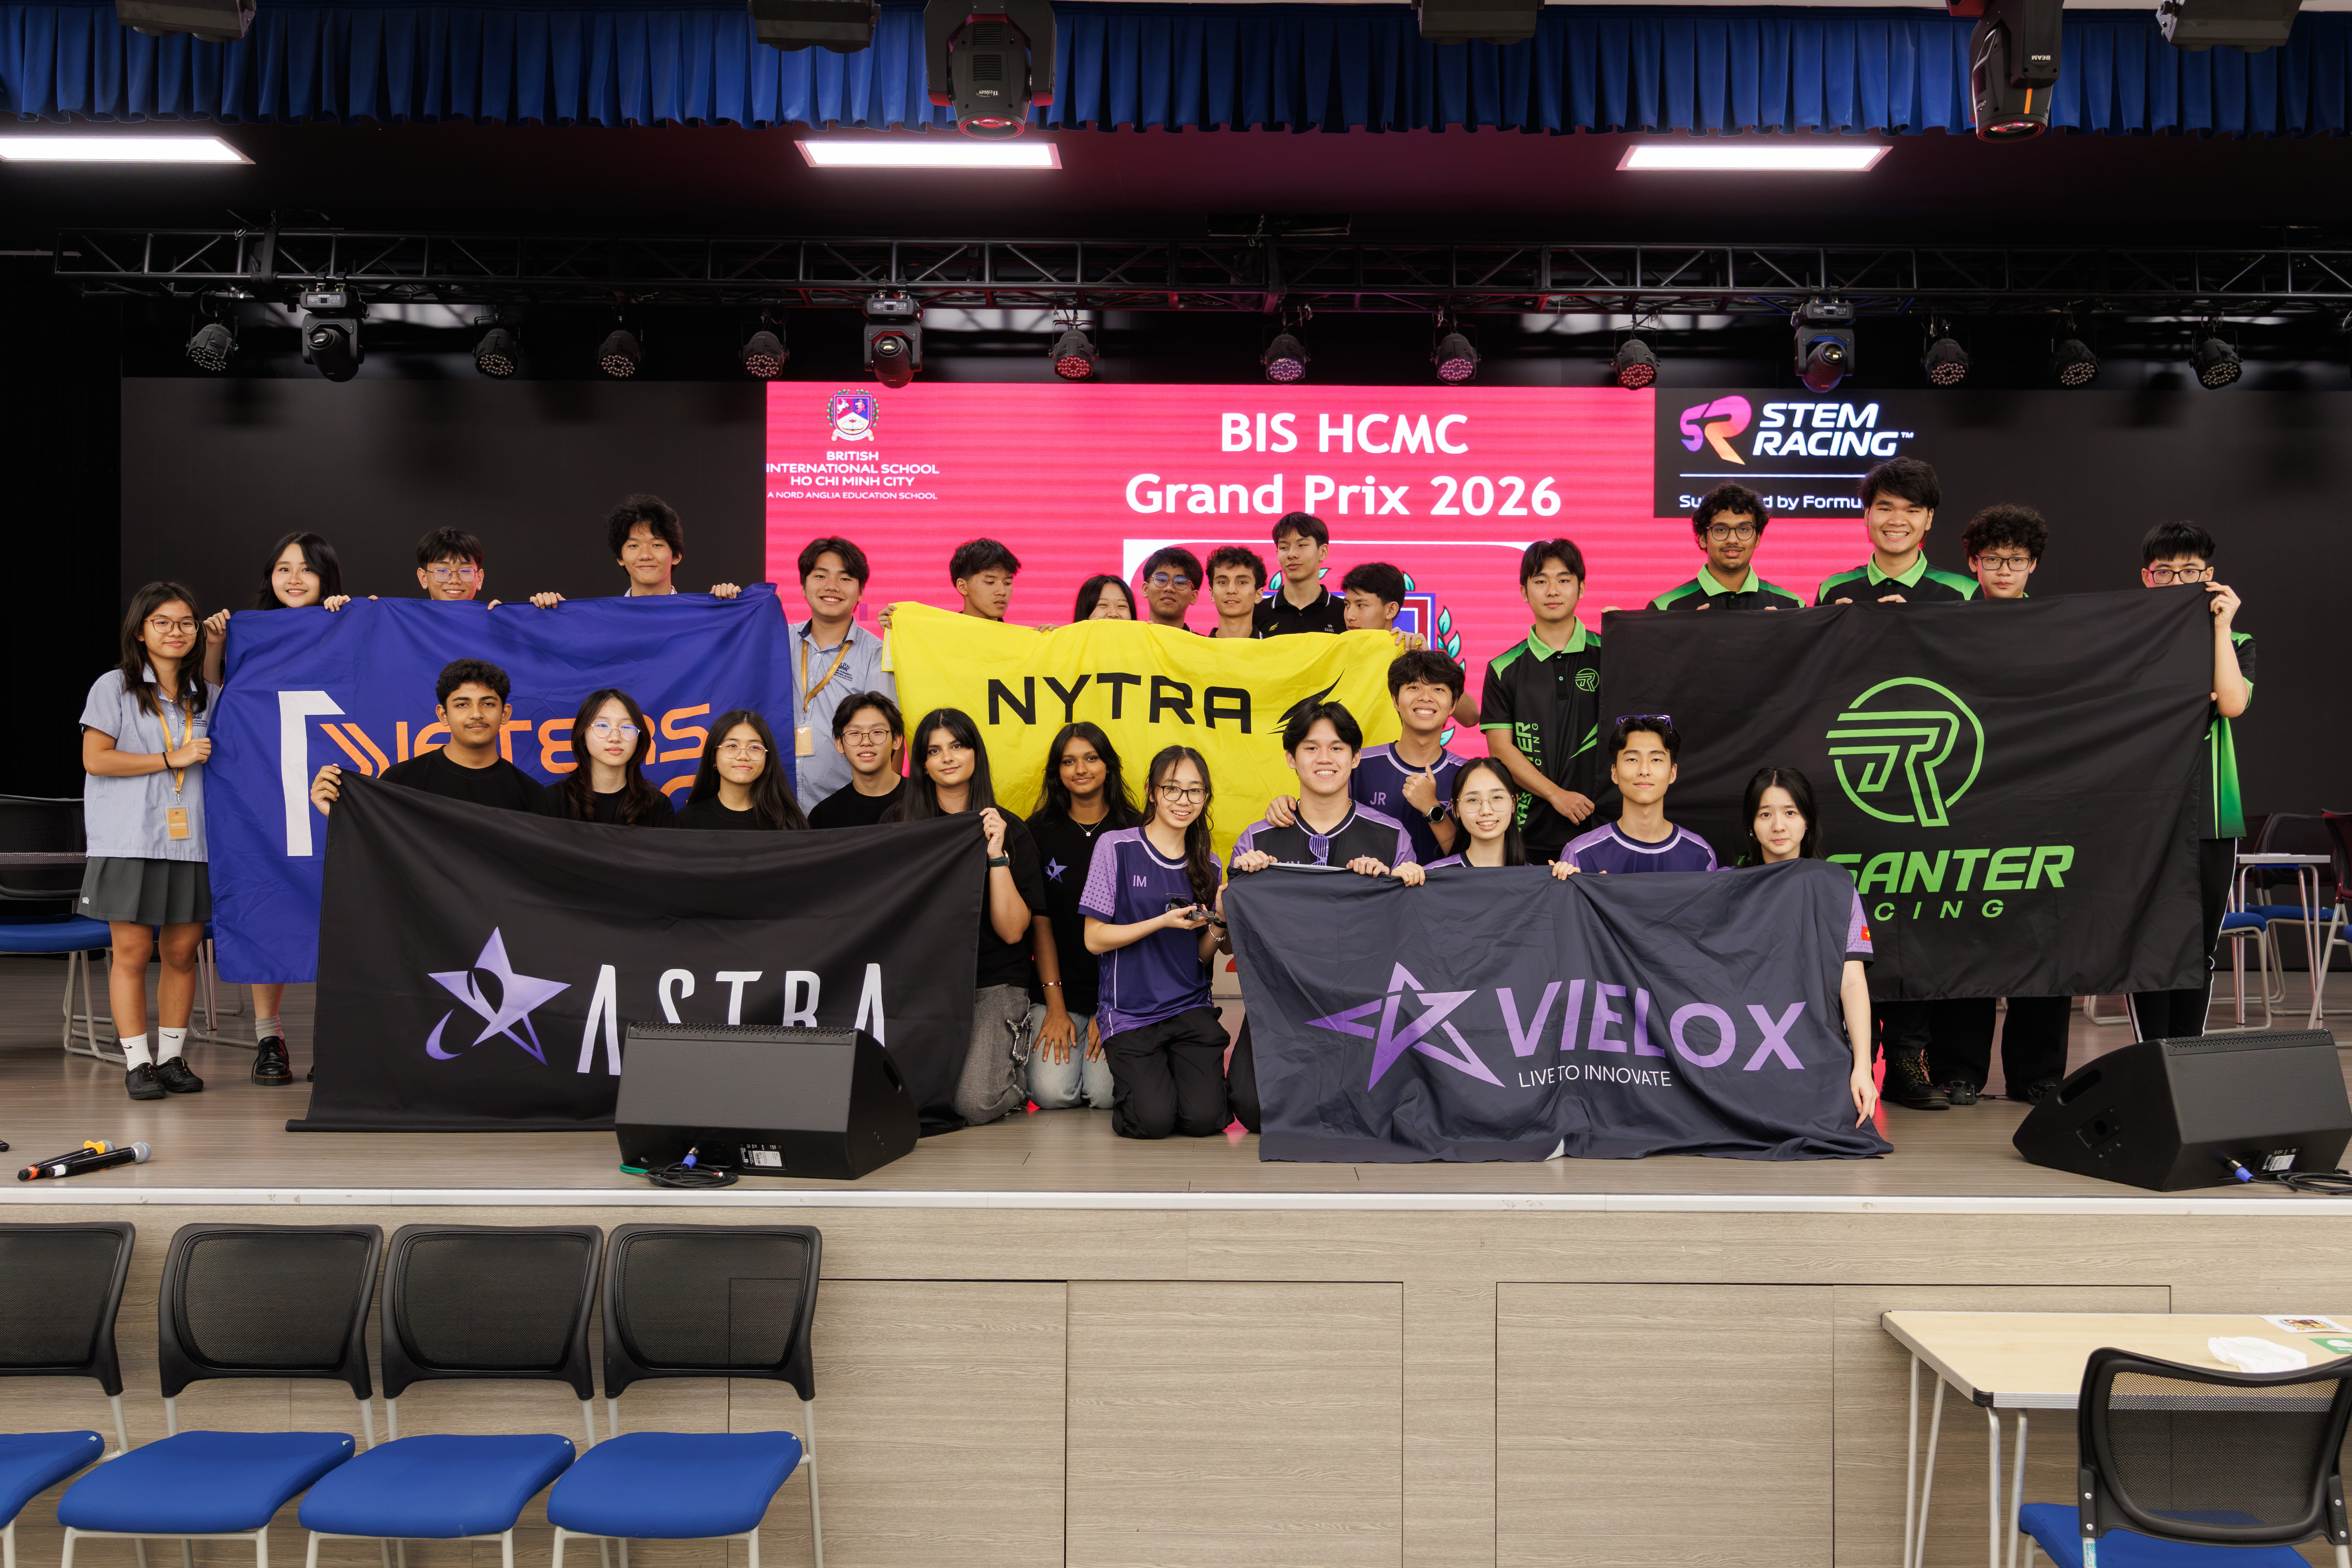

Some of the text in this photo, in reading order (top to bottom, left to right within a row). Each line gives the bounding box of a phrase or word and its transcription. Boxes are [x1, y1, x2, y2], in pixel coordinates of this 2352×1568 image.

[1759, 403, 1879, 428] STEM
[1222, 413, 1468, 454] BIS HCMC
[1752, 431, 1899, 456] RACING
[827, 451, 878, 461] BRITISH
[766, 463, 940, 474] INTERNATIONAL SCHOOL
[791, 476, 915, 486] HO CHI MINH CITY
[1126, 473, 1561, 516] Grand Prix 2026
[1777, 495, 1799, 510] by
[1803, 495, 1863, 508] Formu
[988, 672, 1251, 734] NYTRA
[1369, 792, 1387, 805] JR
[1133, 875, 1146, 887] IM
[1874, 899, 2004, 921] CING
[1495, 979, 1807, 1071] VIELOX
[1518, 1065, 1672, 1088] LIVE TO INNOVATE
